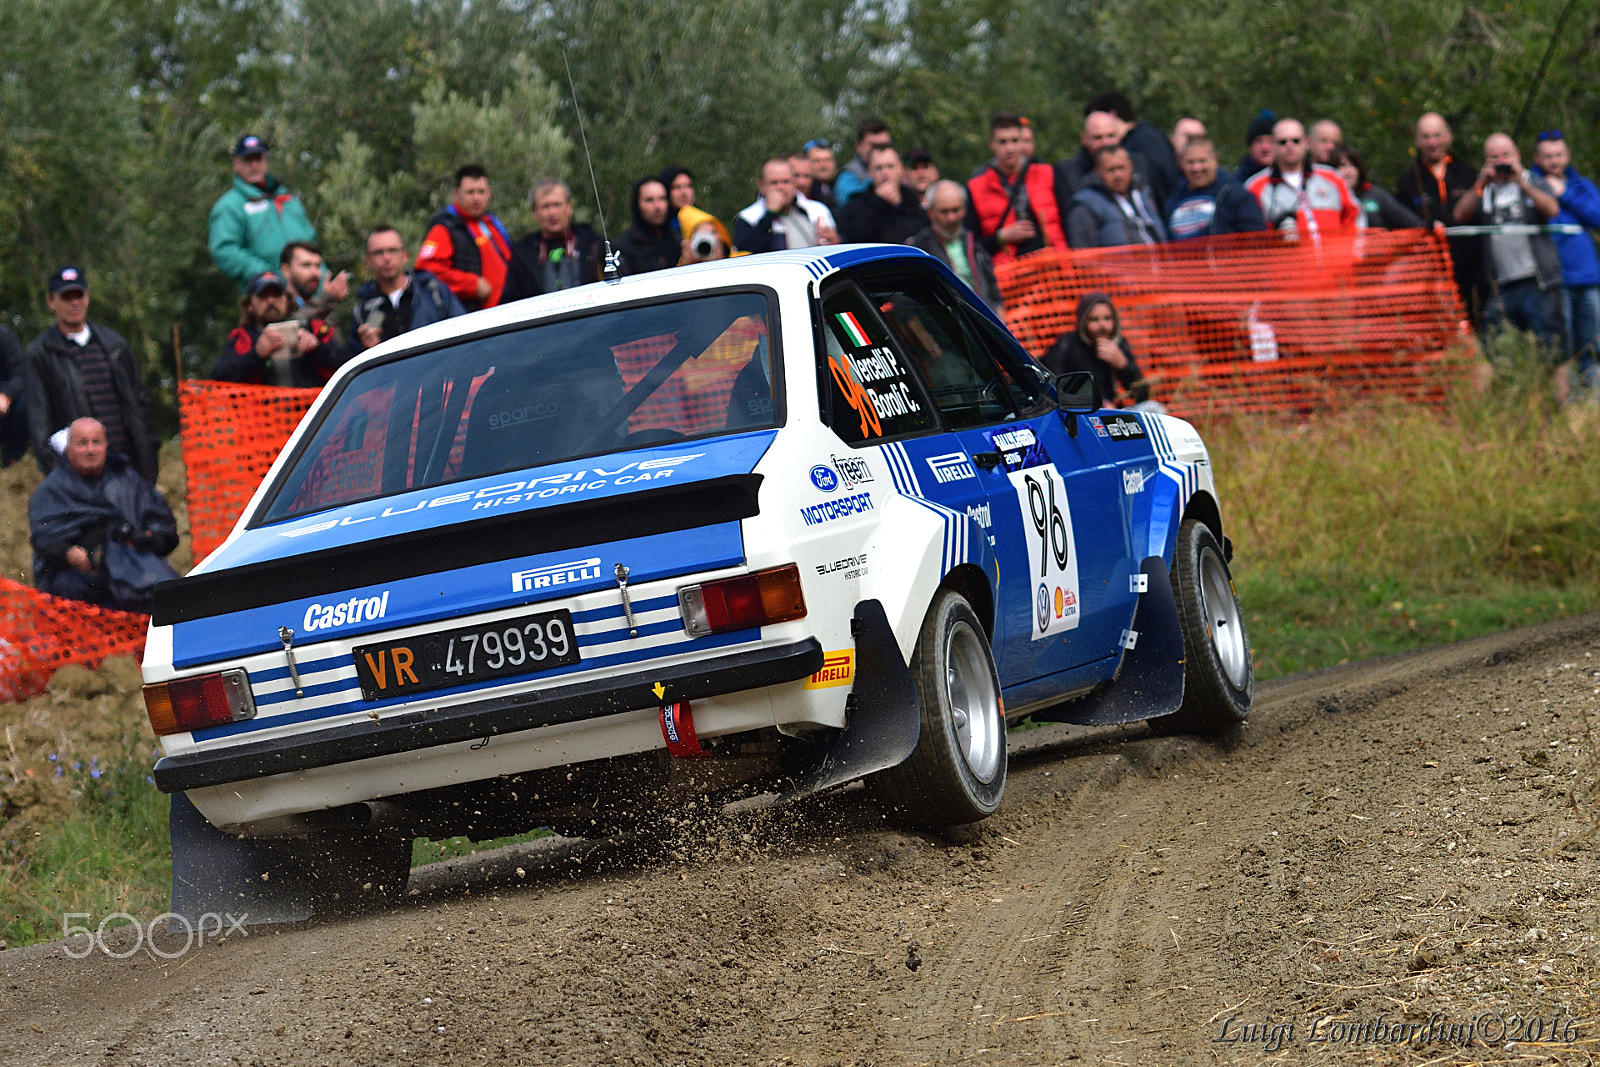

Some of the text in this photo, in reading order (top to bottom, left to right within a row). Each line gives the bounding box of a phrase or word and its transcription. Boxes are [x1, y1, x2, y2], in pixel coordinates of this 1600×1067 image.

[845, 347, 891, 383] Vercelli
[828, 354, 882, 439] 96
[867, 381, 921, 419] Boroli C.
[488, 401, 559, 429] sparco
[831, 454, 874, 490] freem
[926, 452, 975, 483] PIRELLI
[1004, 452, 1021, 465] 2016
[278, 453, 706, 538] BLUEDRIVE
[472, 468, 675, 511] HISTORIC CAR
[800, 492, 874, 526] MOTORSPORT
[1024, 469, 1068, 578] 96
[512, 557, 601, 593] PIRELLI
[816, 554, 867, 575] BLUEDRIVE
[303, 591, 390, 633] Castrol
[365, 619, 569, 690] VR 479939
[664, 704, 677, 741] sparco
